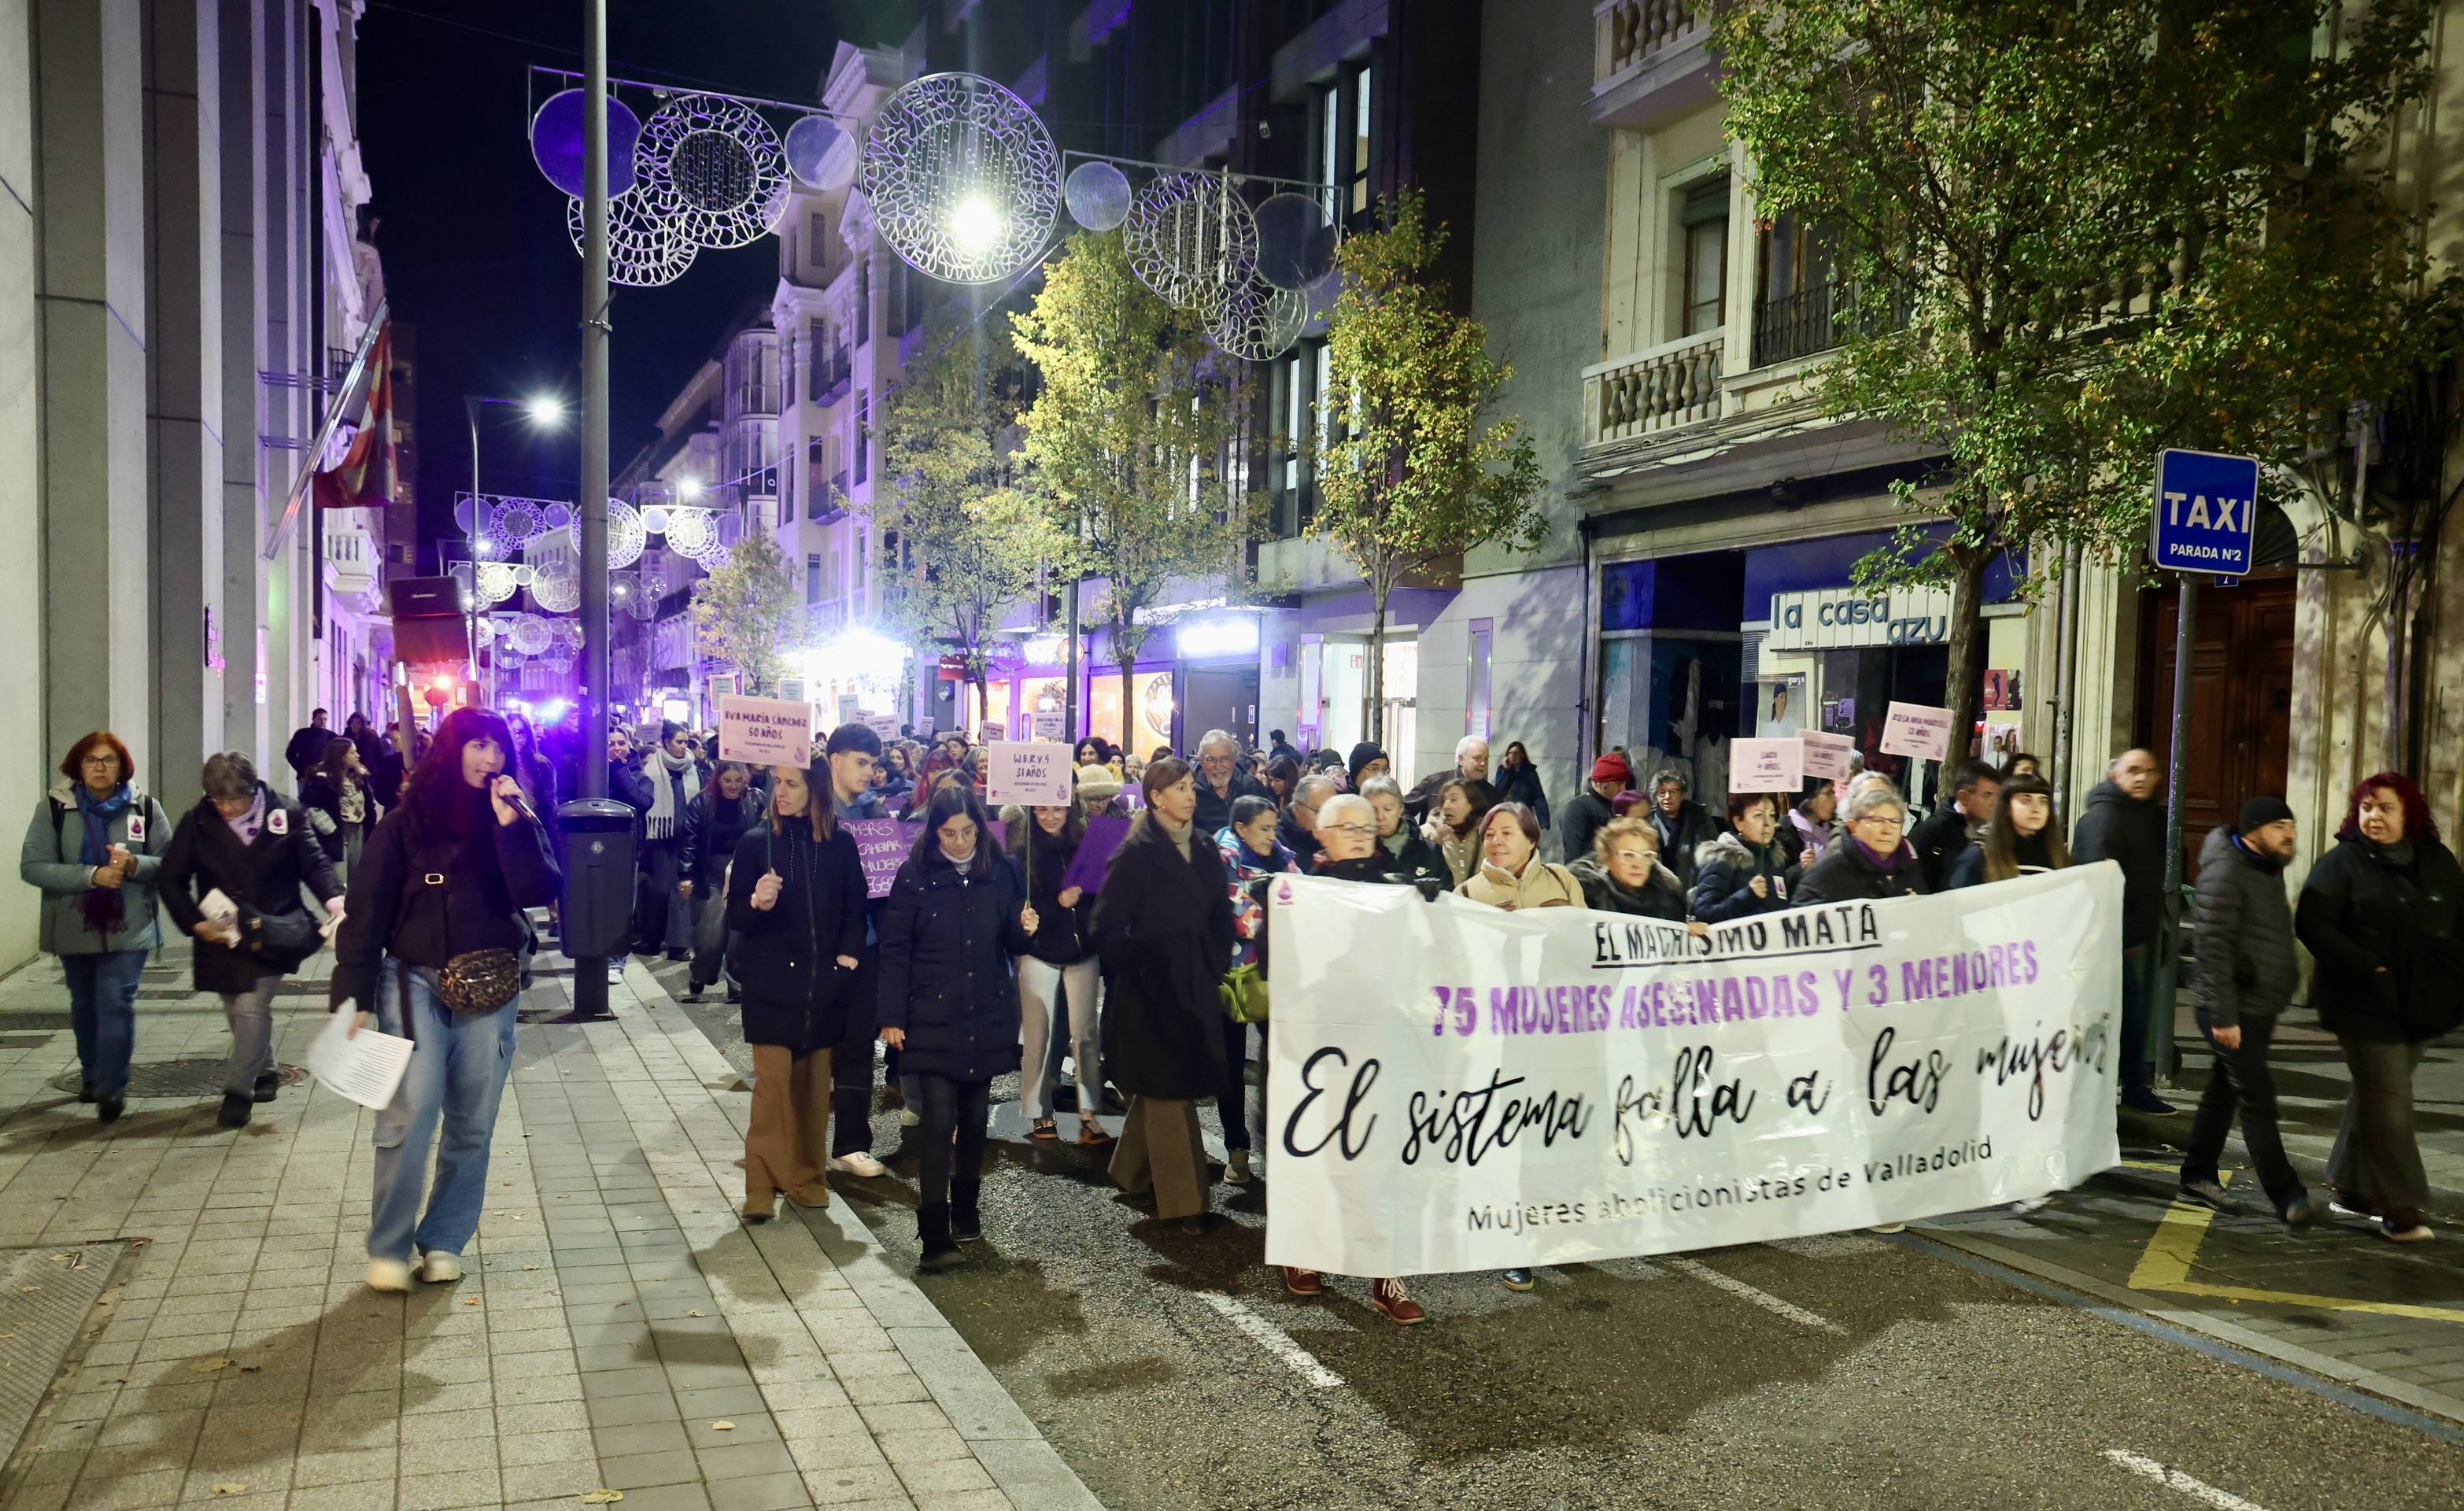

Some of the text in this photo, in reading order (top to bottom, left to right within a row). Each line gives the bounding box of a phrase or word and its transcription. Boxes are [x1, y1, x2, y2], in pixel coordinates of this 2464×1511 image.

[2164, 491, 2251, 534] TAXI
[2170, 543, 2218, 560] PARADA
[1774, 595, 1889, 630] la casa
[748, 726, 783, 740] 50 AÑOS
[1016, 764, 1047, 778] 31 AÑOS
[1595, 903, 1878, 962] EL MACHISMO MATA
[1431, 940, 2039, 1037] 75 MUJERES ASESINADAS Y 3 MENORES
[1284, 1046, 1380, 1161] El
[1402, 1068, 1594, 1166] sistema
[1616, 1045, 1757, 1166] falla
[1787, 1070, 1834, 1115] a
[1868, 1026, 1952, 1117] las
[1467, 1134, 1993, 1236] Mujeres abolicionistas de Valladolid
